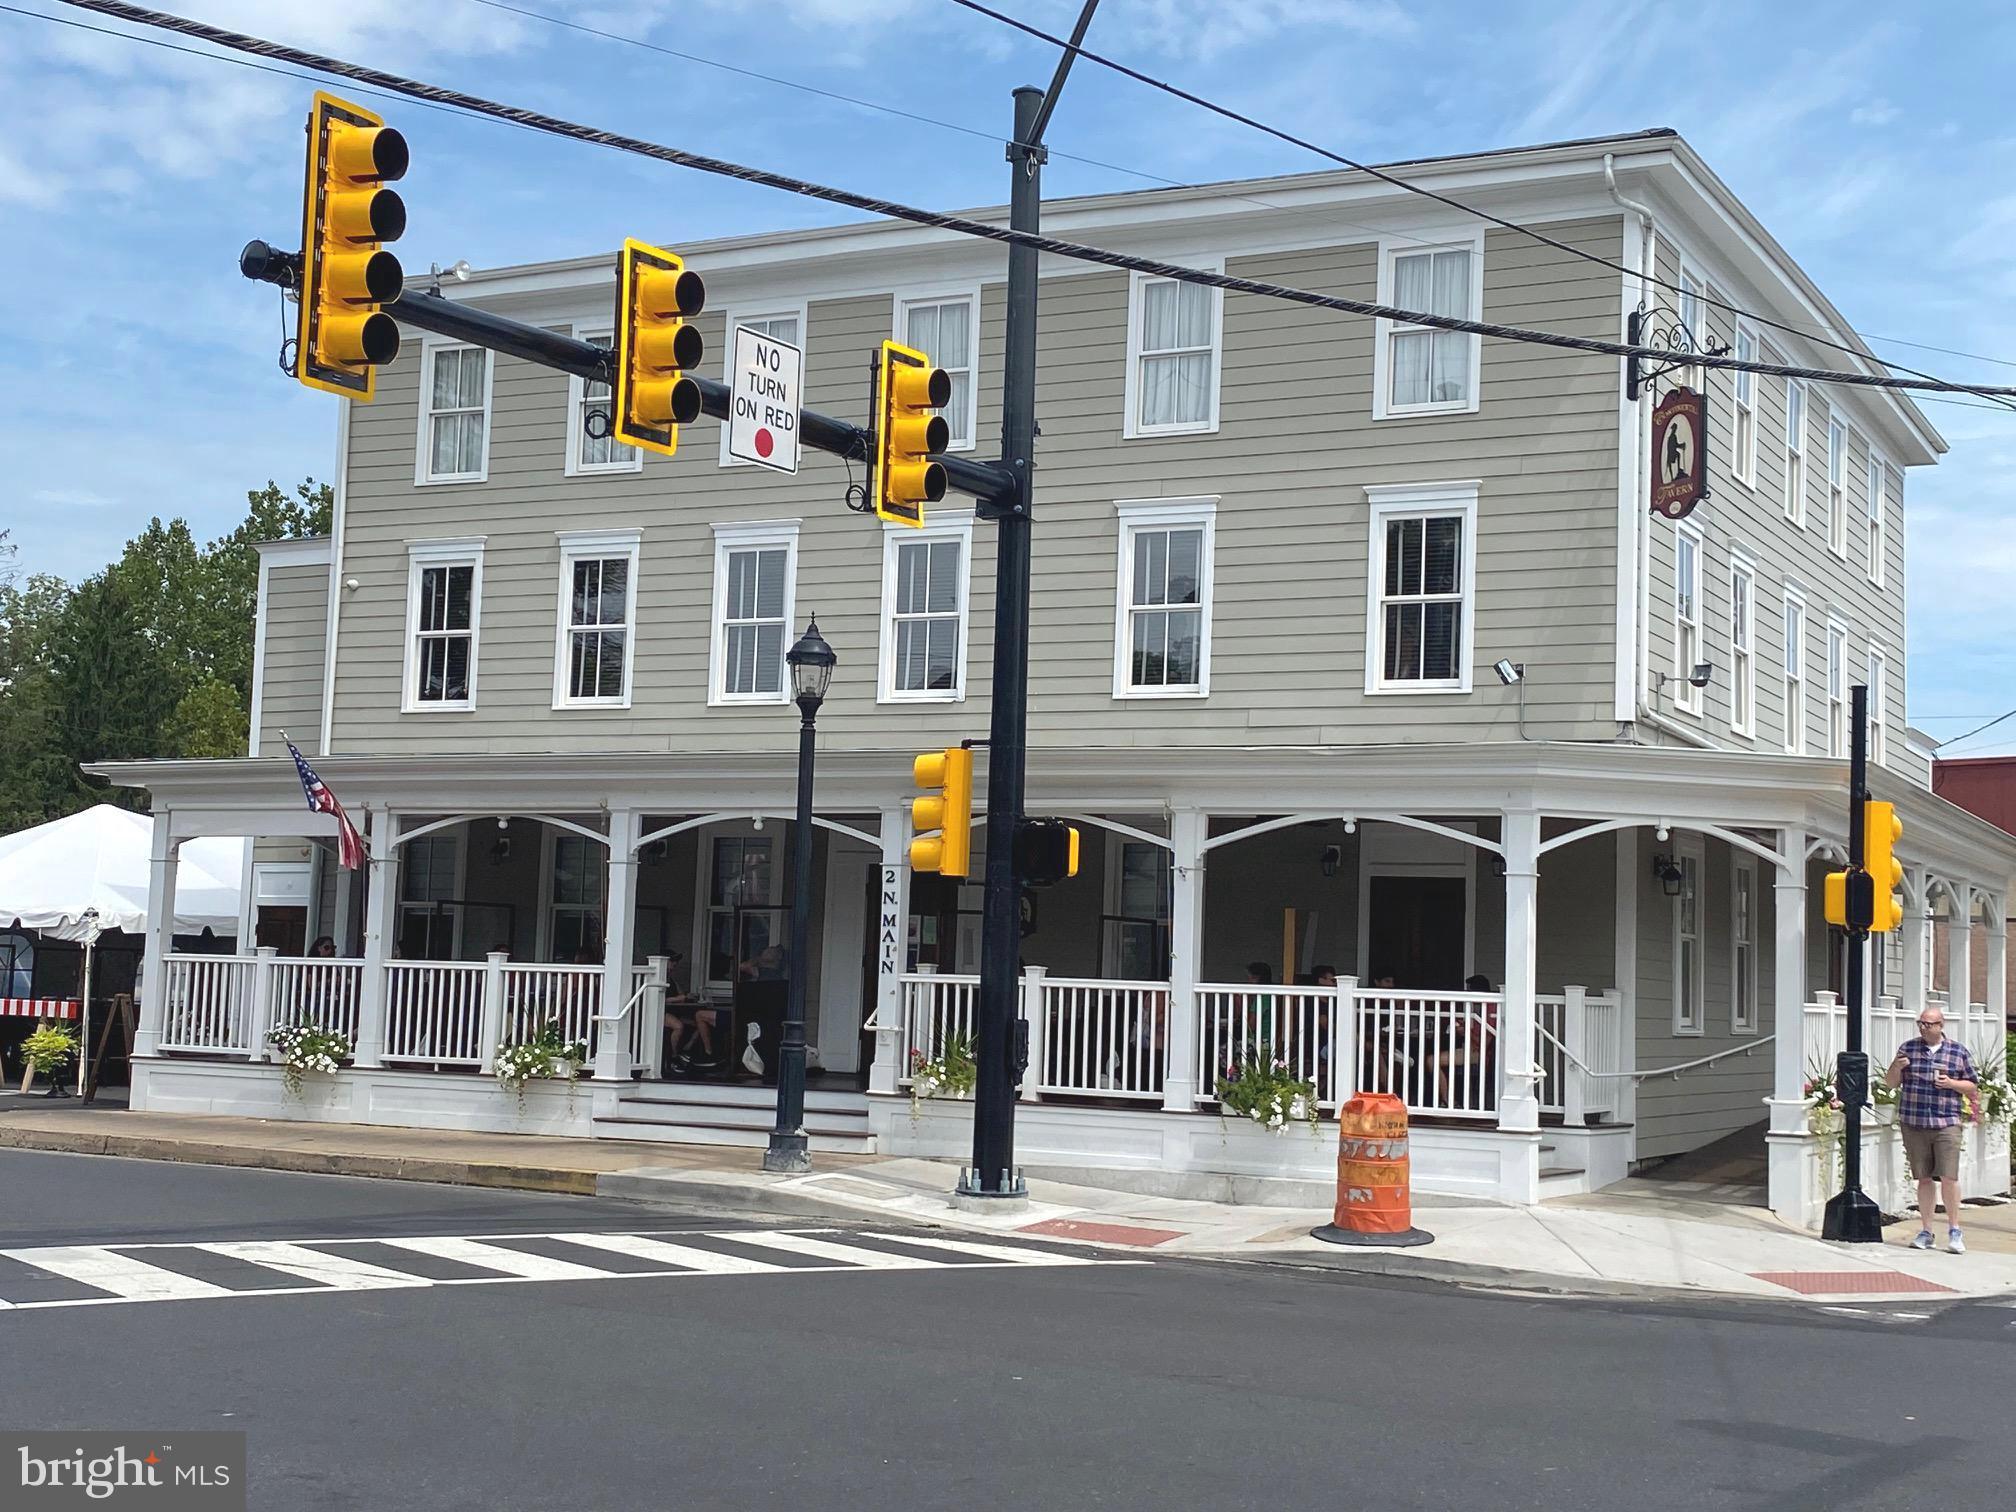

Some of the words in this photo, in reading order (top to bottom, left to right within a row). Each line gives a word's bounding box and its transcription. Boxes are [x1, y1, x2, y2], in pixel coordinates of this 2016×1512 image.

[756, 343, 780, 372] NO
[748, 371, 786, 402] TURN
[736, 397, 757, 421] ON
[765, 405, 794, 431] RED
[1655, 482, 1694, 504] TAVERN
[885, 870, 895, 883] 2
[883, 891, 898, 905] N.
[881, 914, 896, 974] MAIN
